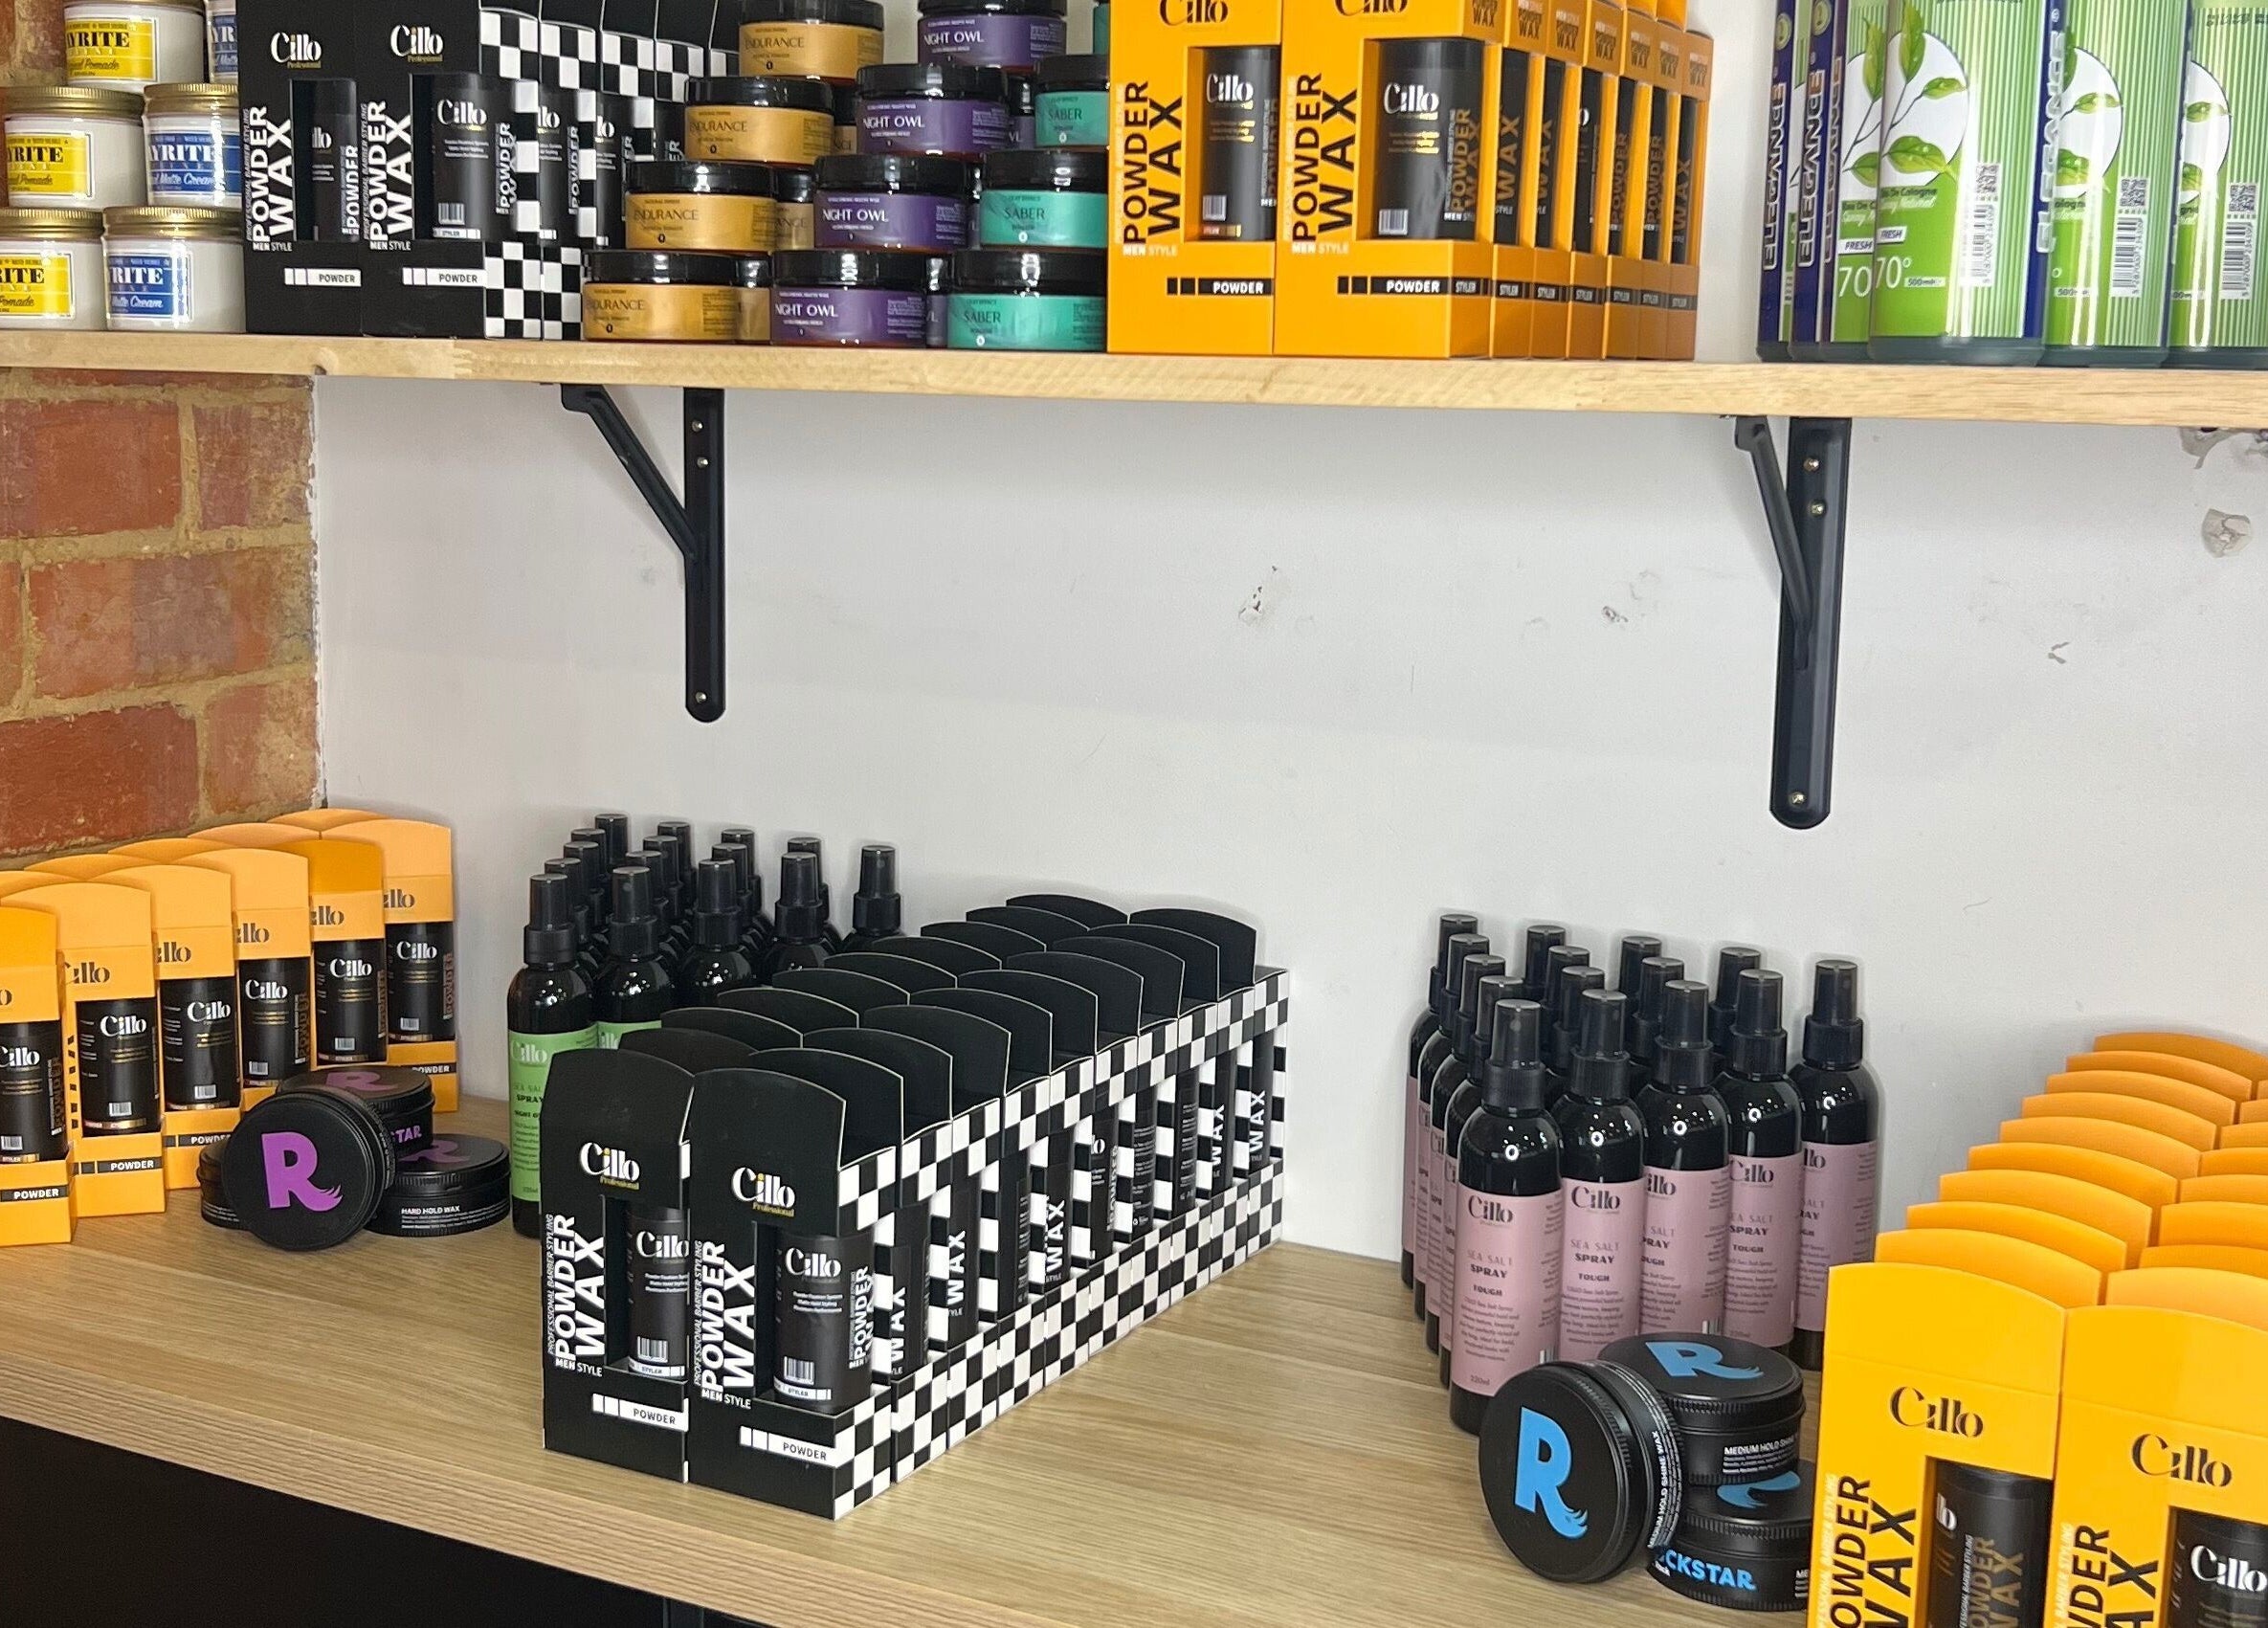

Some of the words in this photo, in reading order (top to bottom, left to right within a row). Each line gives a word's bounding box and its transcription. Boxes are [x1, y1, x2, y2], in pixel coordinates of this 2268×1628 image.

[1474, 9, 1495, 28] WAX
[1519, 20, 1540, 40] WAX
[271, 32, 322, 63] Cillo
[390, 25, 443, 57] Cillo
[953, 31, 984, 43] OWL
[1557, 32, 1576, 51] WAX
[1595, 40, 1614, 61] WAX
[1206, 73, 1254, 103] Cillo
[1384, 82, 1439, 114] Cillo
[436, 99, 487, 125] Cillo
[894, 115, 925, 128] OWL
[500, 123, 511, 208] POWDER
[1123, 81, 1148, 244] POWDER
[1147, 96, 1183, 236] WAX
[1292, 73, 1323, 241] POWDER
[1318, 89, 1357, 234] WAX
[1450, 109, 1471, 212] POWDER
[1496, 116, 1521, 201] WAX
[1797, 69, 1825, 267] ELEGANCE
[249, 105, 271, 242] POWDER
[266, 119, 295, 235] WAX
[367, 100, 389, 241] POWDER
[384, 114, 413, 234] WAX
[1647, 136, 1663, 224] POWDER
[856, 209, 889, 223] OWL
[1005, 207, 1045, 219] SABER
[369, 240, 388, 251] MEN
[389, 240, 411, 251] STYLE
[1123, 244, 1146, 256] MEN
[1148, 244, 1177, 256] STYLE
[1292, 242, 1316, 254] MEN
[1319, 242, 1349, 255] STYLE
[1845, 240, 1873, 251] FRESH
[319, 274, 356, 283] POWDER
[438, 273, 478, 283] POWDER
[1212, 281, 1264, 295] POWDER
[1386, 279, 1440, 294] POWDER
[1839, 266, 1872, 298] 70
[806, 303, 838, 318] OWL
[965, 310, 1001, 323] SABER
[396, 941, 437, 960] Cillo
[330, 958, 372, 978] Cillo
[245, 979, 288, 1000] Cillo
[187, 1001, 231, 1023] Cillo
[100, 1015, 147, 1037] Cillo
[1249, 1089, 1266, 1153] WAX
[390, 1125, 422, 1144] TAR
[110, 1160, 154, 1171] POWDER
[260, 1130, 343, 1213] R
[581, 1142, 640, 1182] Cillo
[1729, 1158, 1774, 1184] Cillo
[13, 1188, 59, 1200] POWDER
[599, 1175, 640, 1191] Professional
[732, 1167, 795, 1209] Cillo
[401, 1207, 421, 1215] HARD
[422, 1206, 443, 1215] HOLD
[444, 1205, 460, 1214] WAX
[752, 1201, 795, 1217] Professional
[1468, 1194, 1513, 1223] Cillo
[1571, 1186, 1620, 1210] Cillo
[1651, 1225, 1676, 1238] SALT
[1729, 1224, 1768, 1237] SPRAY
[1749, 1214, 1773, 1224] SALT
[545, 1214, 554, 1251] STYLING
[636, 1231, 689, 1259] Cillo
[1045, 1199, 1065, 1273] WAX
[1570, 1238, 1590, 1251] SEA
[1595, 1238, 1620, 1252] SALT
[694, 1240, 703, 1280] STYLING
[1574, 1252, 1615, 1265] SPRAY
[1733, 1244, 1764, 1254] TOUGH
[785, 1247, 842, 1278] Cillo
[946, 1230, 967, 1305] WAX
[1471, 1263, 1508, 1280] SPRAY
[553, 1215, 577, 1361] POWDER
[1473, 1283, 1503, 1297] TOUGH
[1578, 1273, 1611, 1282] TOUGH
[574, 1232, 606, 1357] WAX
[694, 1281, 703, 1318] BARBER
[701, 1240, 724, 1392] POWDER
[723, 1260, 755, 1388] WAX
[854, 1265, 868, 1360] POWDER
[694, 1319, 703, 1386] PROFESSIONAL
[555, 1357, 575, 1371] MEN
[576, 1362, 603, 1378] STYLE
[701, 1389, 723, 1402] MEN
[724, 1393, 751, 1410] STYLE
[1889, 1385, 1984, 1438] Cillo
[633, 1408, 676, 1425] POWDER
[782, 1440, 827, 1461] POWDER
[1652, 1430, 1664, 1455] WAX
[1723, 1443, 1759, 1455] MEDIUM
[1759, 1440, 1780, 1452] HOLD
[1514, 1406, 1589, 1540] R
[1658, 1456, 1669, 1486] SHINE
[2131, 1433, 2233, 1488] Cillo
[1964, 1533, 1973, 1564] STYLING
[1660, 1549, 1757, 1591] CKSTAR
[1962, 1563, 1971, 1593] BARBER
[2190, 1545, 2268, 1593] Cillo
